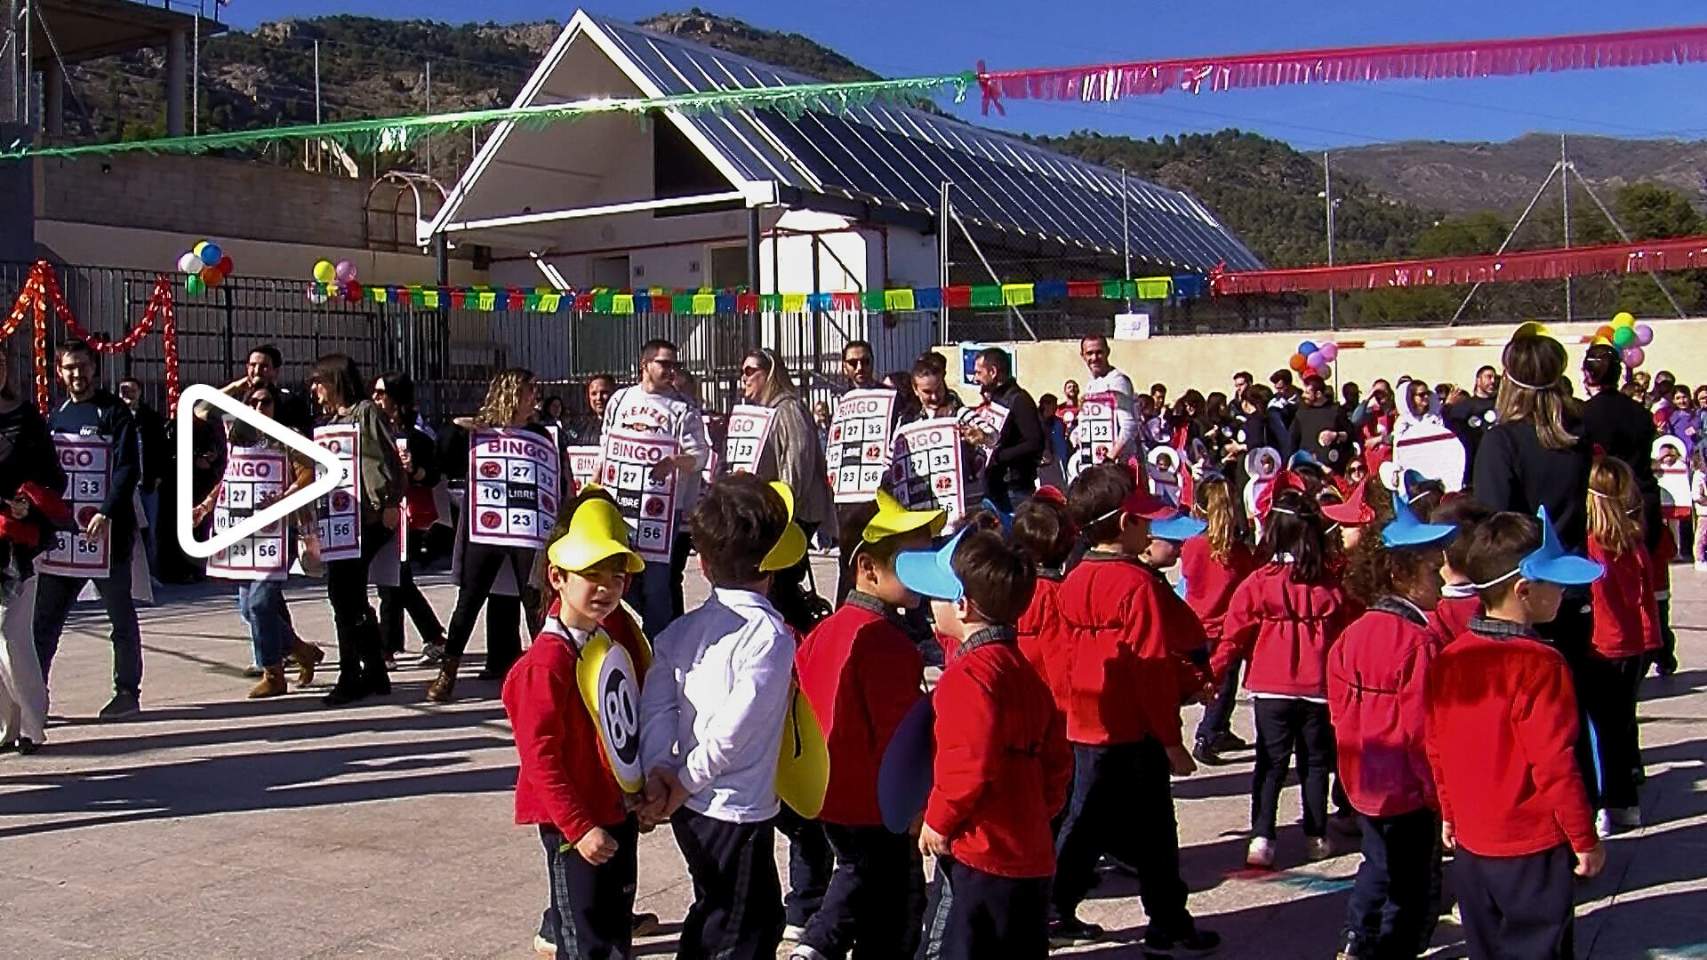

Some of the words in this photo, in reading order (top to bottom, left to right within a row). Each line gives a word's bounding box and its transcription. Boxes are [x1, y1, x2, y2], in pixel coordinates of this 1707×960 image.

[622, 406, 668, 425] KENZO
[848, 426, 858, 435] 27
[868, 425, 881, 434] 33
[488, 440, 548, 462] BINGO
[612, 442, 662, 461] BINGO
[739, 445, 752, 456] 33
[866, 447, 880, 457] 42
[60, 450, 93, 467] GO
[577, 457, 597, 470] BIN
[911, 460, 922, 472] 27
[934, 455, 949, 465] 33
[231, 462, 270, 477] NGO
[513, 467, 529, 477] 27
[623, 472, 637, 483] 27
[843, 472, 855, 482] 23
[935, 477, 952, 489] 42
[80, 481, 99, 494] 33
[484, 488, 501, 499] 10
[508, 489, 535, 499] LIBRE
[233, 490, 246, 502] 27
[618, 496, 640, 508] LIBRE
[512, 515, 530, 526] 23
[334, 523, 349, 536] 56
[643, 527, 660, 539] 56
[57, 537, 66, 551] 3
[78, 539, 98, 553] 56
[233, 545, 247, 556] 23
[259, 545, 276, 557] 56
[606, 679, 637, 749] 80
